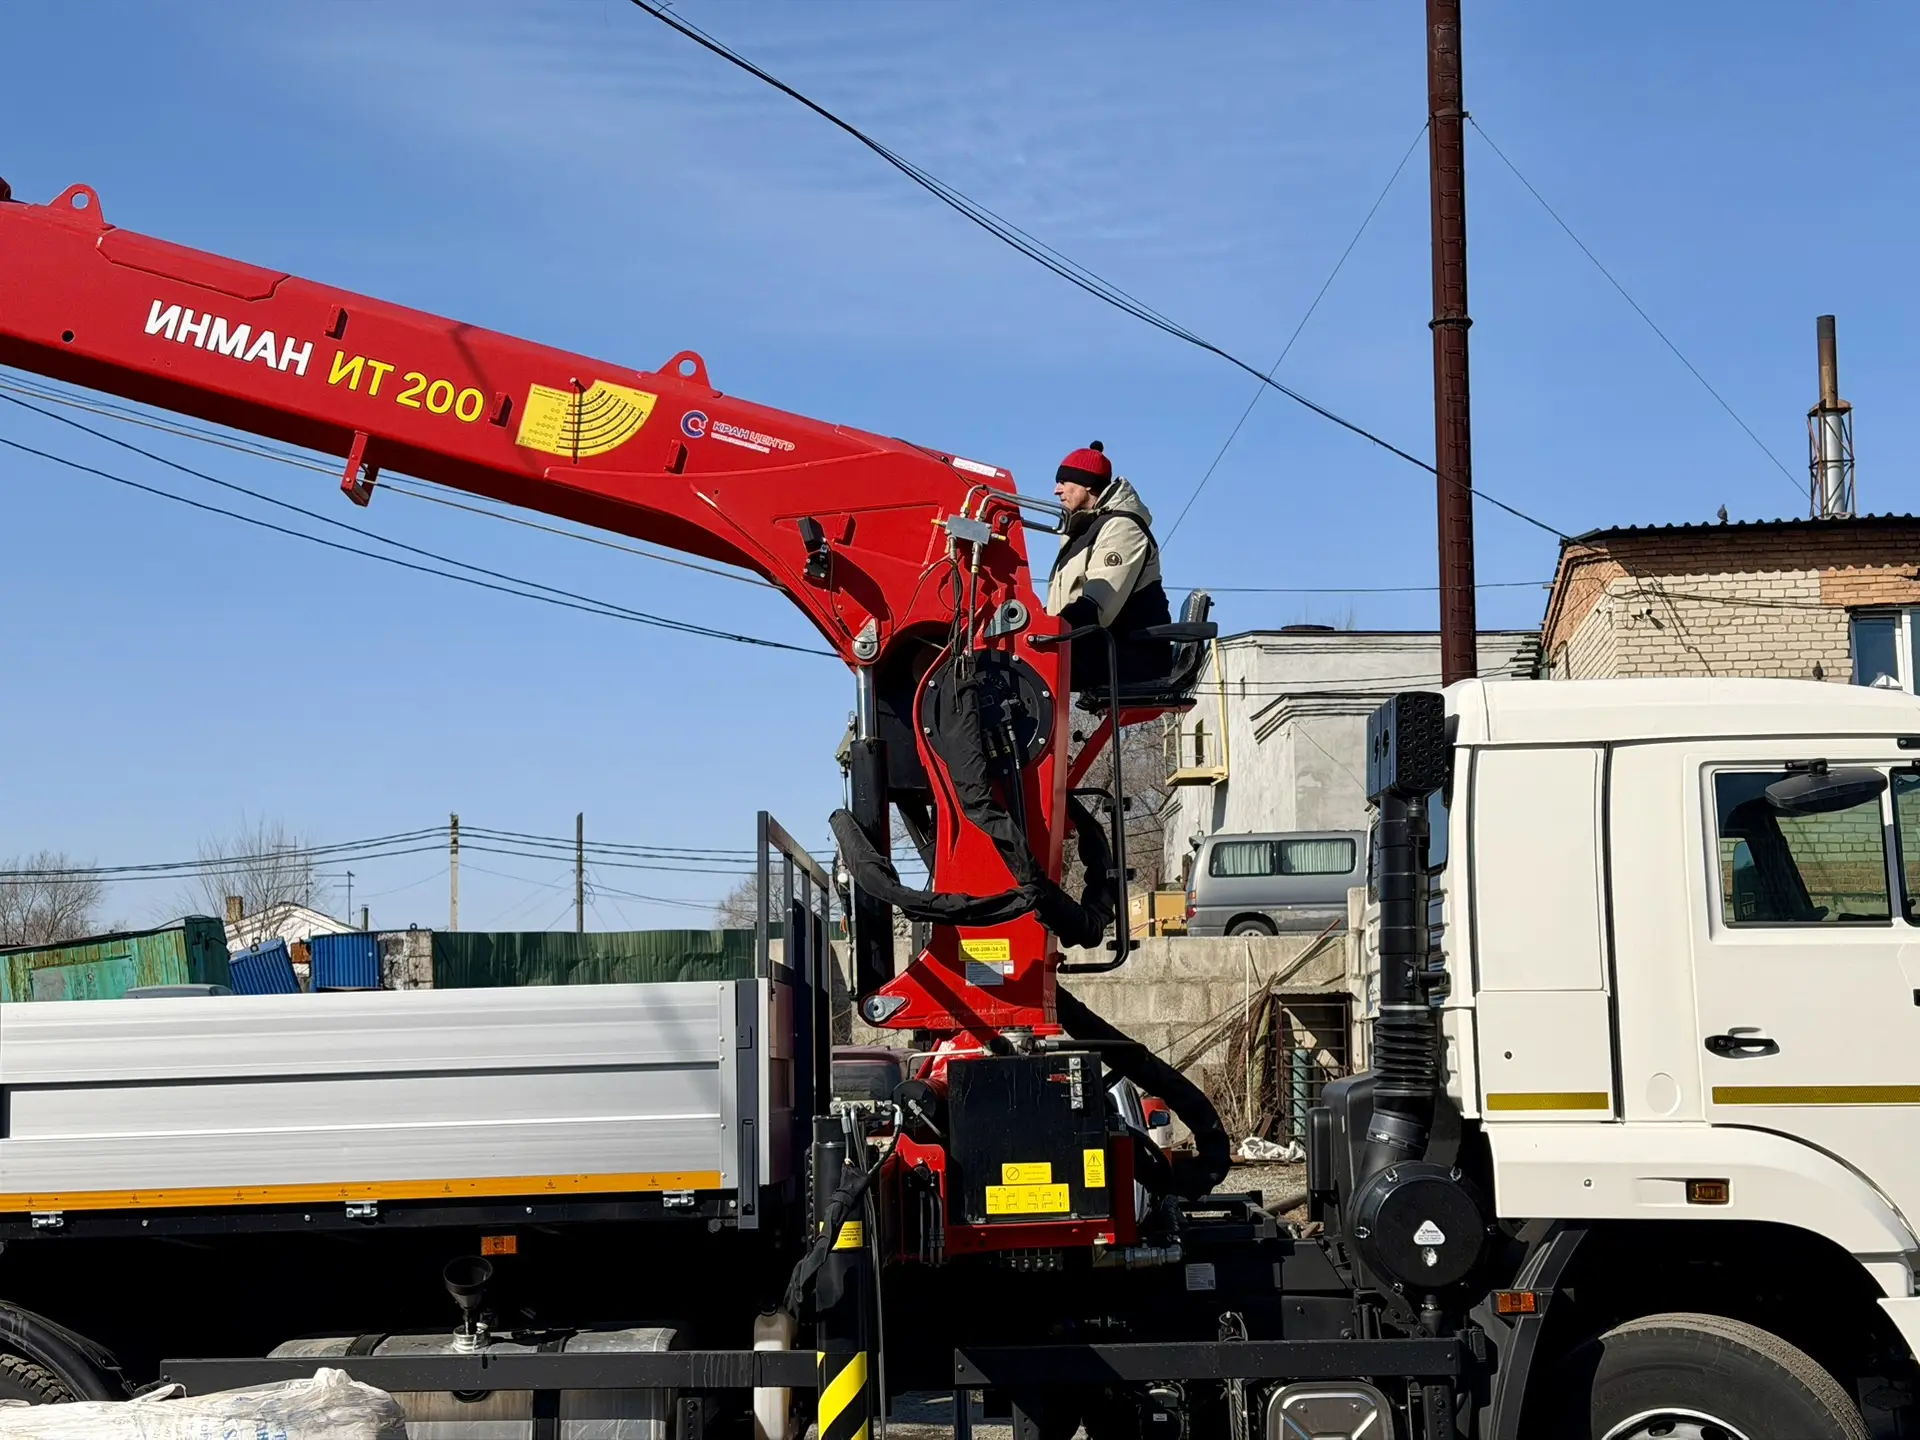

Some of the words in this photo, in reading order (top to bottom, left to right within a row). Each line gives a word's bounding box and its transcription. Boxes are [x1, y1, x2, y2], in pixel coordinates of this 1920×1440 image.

[144, 299, 314, 377] ИНМАН
[327, 350, 395, 396] ИТ
[395, 371, 485, 423] 200
[712, 421, 750, 440] КРАН
